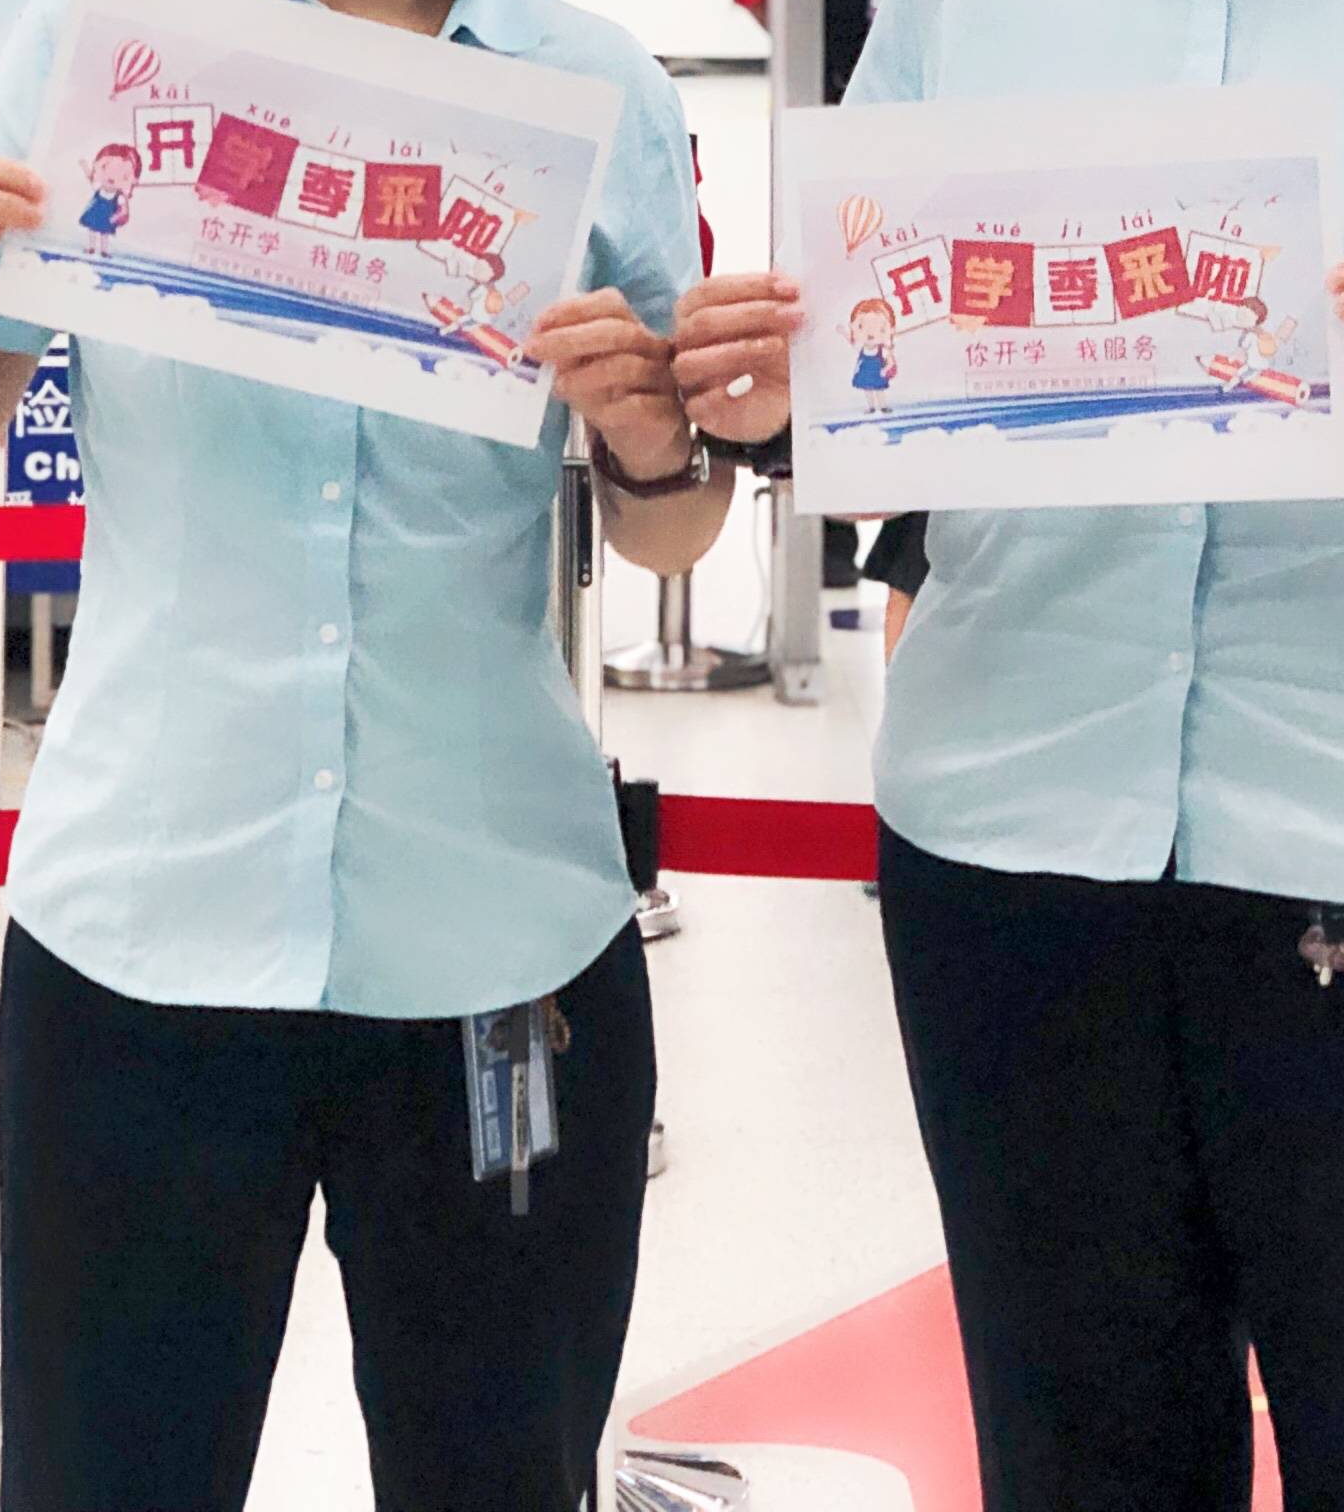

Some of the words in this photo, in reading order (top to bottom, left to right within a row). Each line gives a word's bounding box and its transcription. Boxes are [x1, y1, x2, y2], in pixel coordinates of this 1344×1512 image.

[965, 340, 1046, 367] 你开学
[1076, 336, 1156, 361] 我服务
